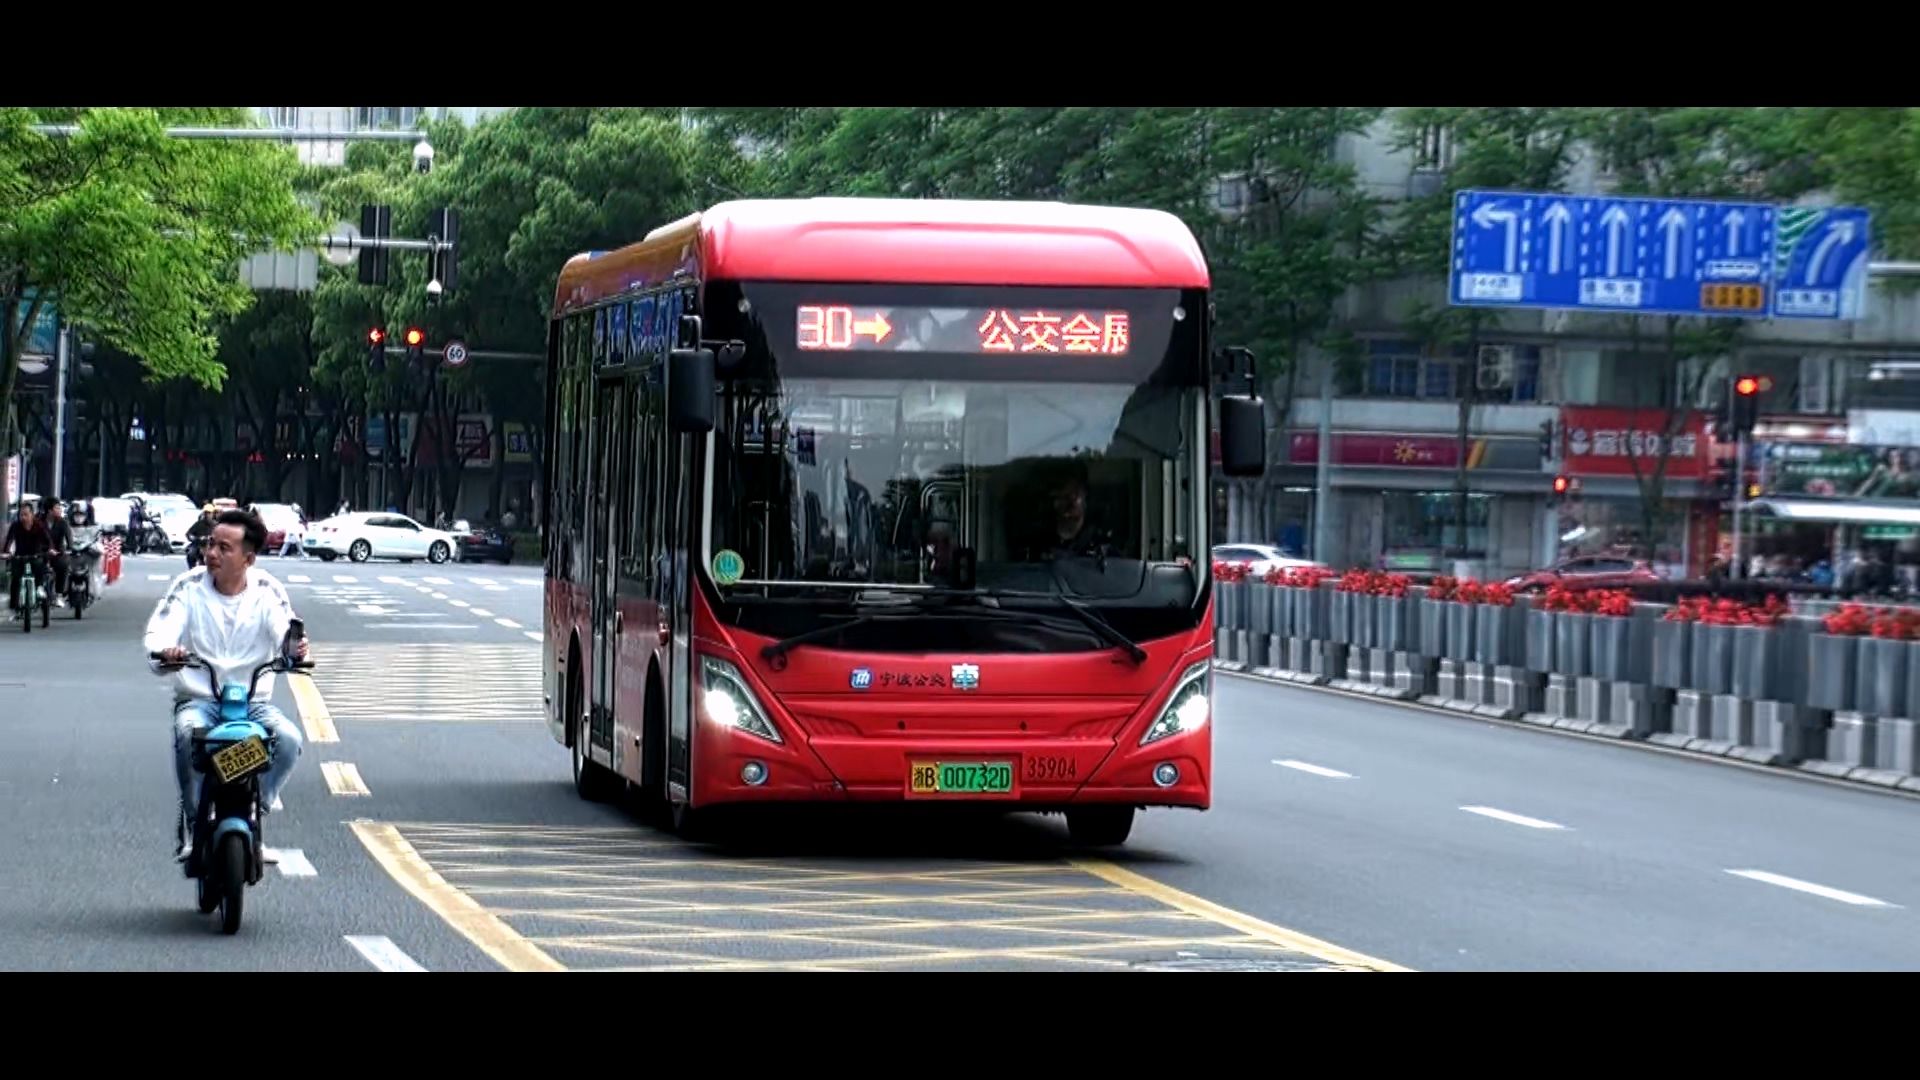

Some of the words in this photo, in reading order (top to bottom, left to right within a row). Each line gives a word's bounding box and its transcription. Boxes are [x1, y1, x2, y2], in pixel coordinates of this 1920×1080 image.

[798, 306, 852, 348] 30
[449, 347, 463, 360] 60
[880, 672, 947, 687] 宁波公交
[1027, 757, 1077, 779] 35904
